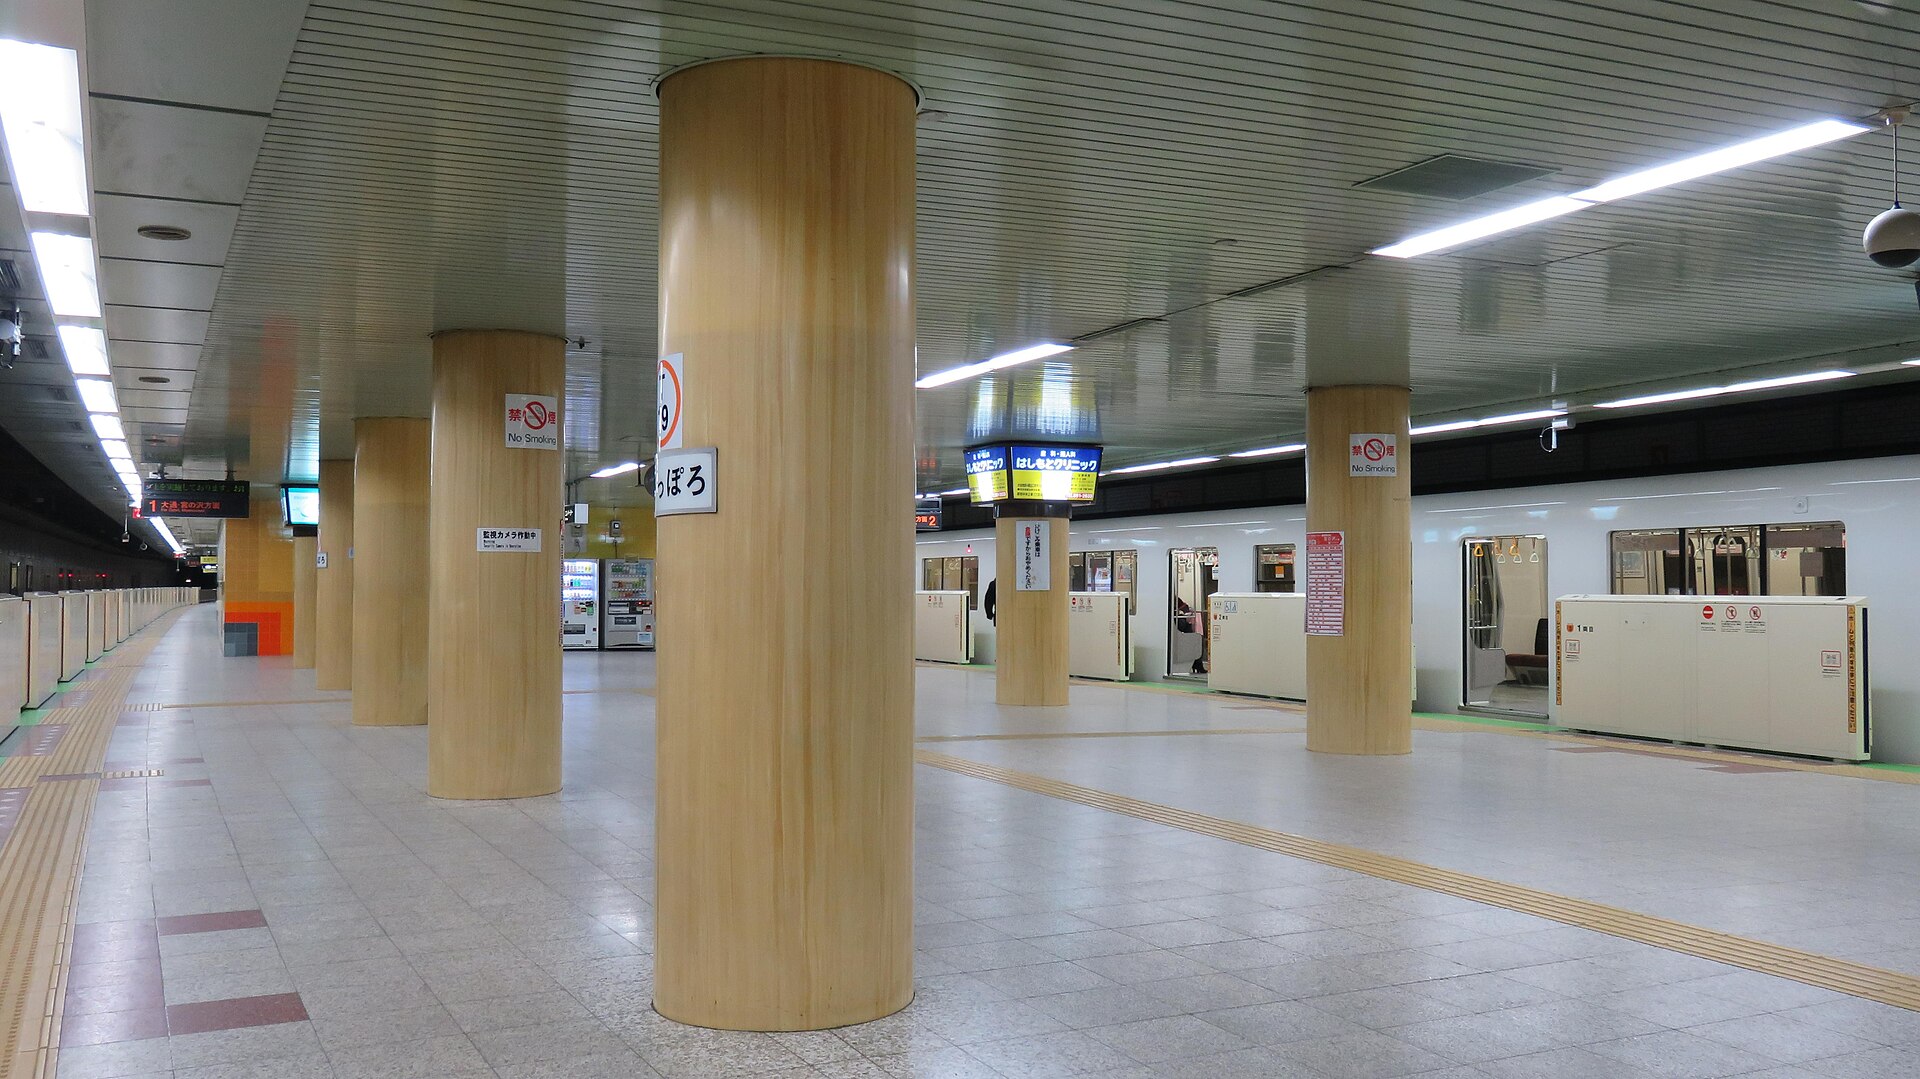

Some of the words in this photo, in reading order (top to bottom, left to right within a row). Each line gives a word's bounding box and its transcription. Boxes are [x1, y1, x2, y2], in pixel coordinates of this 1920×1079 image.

[508, 408, 522, 421] 禁
[657, 404, 669, 431] 9
[508, 433, 522, 442] No
[524, 433, 556, 445] Smoking
[1351, 445, 1362, 456] 禁
[1016, 457, 1097, 471] はしもとクリニック
[1352, 464, 1363, 472] No
[1365, 464, 1396, 473] Smoking
[149, 499, 157, 512] 1
[928, 515, 936, 526] 2
[483, 530, 536, 539] 監視カメラ作動中
